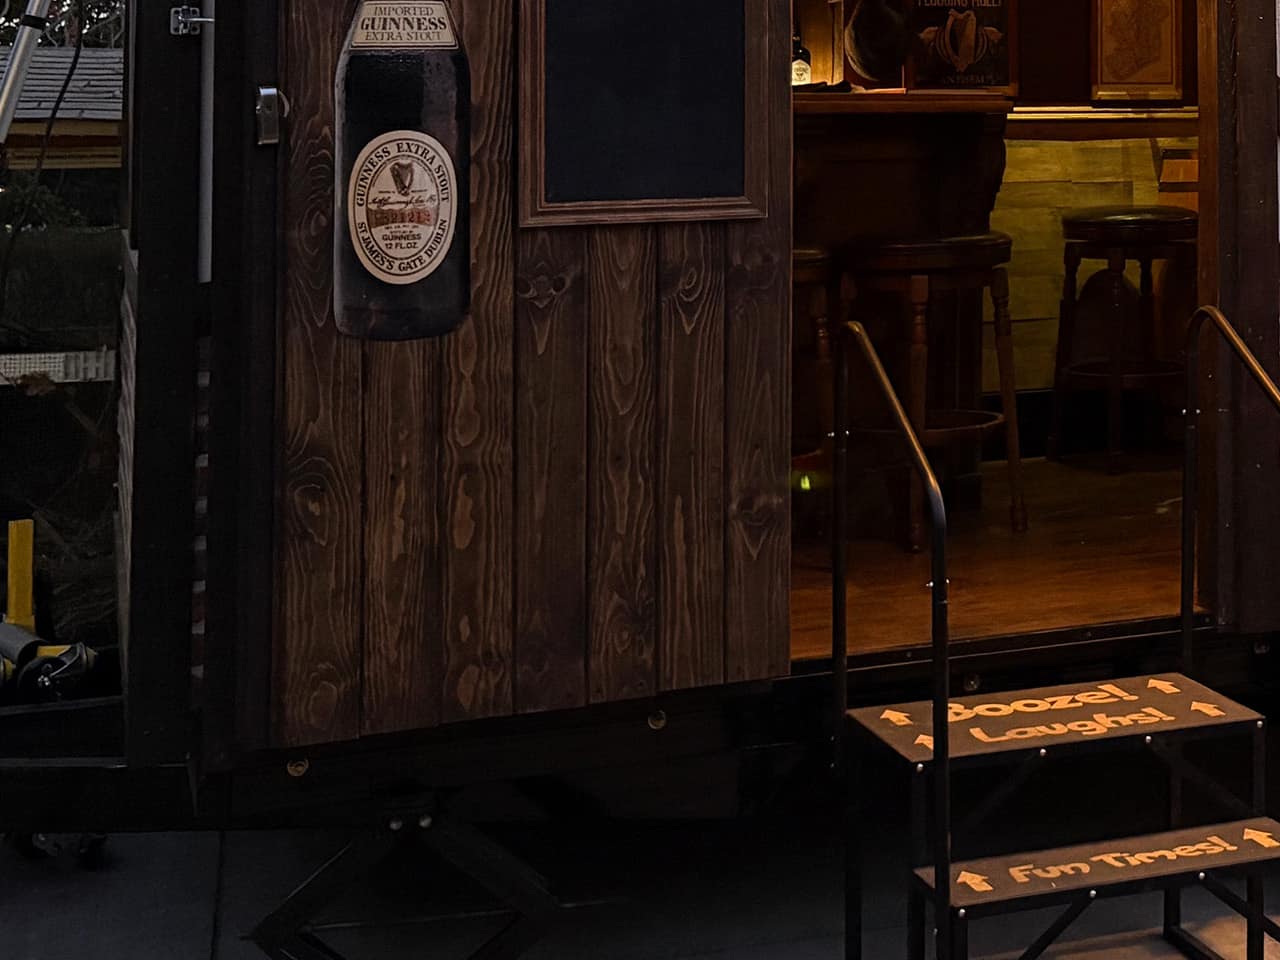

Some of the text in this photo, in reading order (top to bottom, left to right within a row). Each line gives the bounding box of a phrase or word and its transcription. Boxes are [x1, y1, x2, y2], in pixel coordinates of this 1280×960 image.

[360, 16, 448, 32] GUINNESS
[374, 6, 434, 17] IMPORTED
[365, 31, 442, 41] EXTRA STOUT
[356, 145, 391, 207] GUINNESS
[396, 142, 436, 166] EXTRA
[434, 164, 450, 202] STOUT
[361, 232, 395, 271] JAMES'S
[398, 257, 426, 272] GATE
[426, 218, 448, 259] DUBLIN
[382, 233, 422, 242] GUINNESS
[385, 242, 394, 250] 12
[947, 683, 1140, 723] Booze!
[969, 706, 1176, 744] Laughs!
[1008, 835, 1239, 884] Fun Times!
